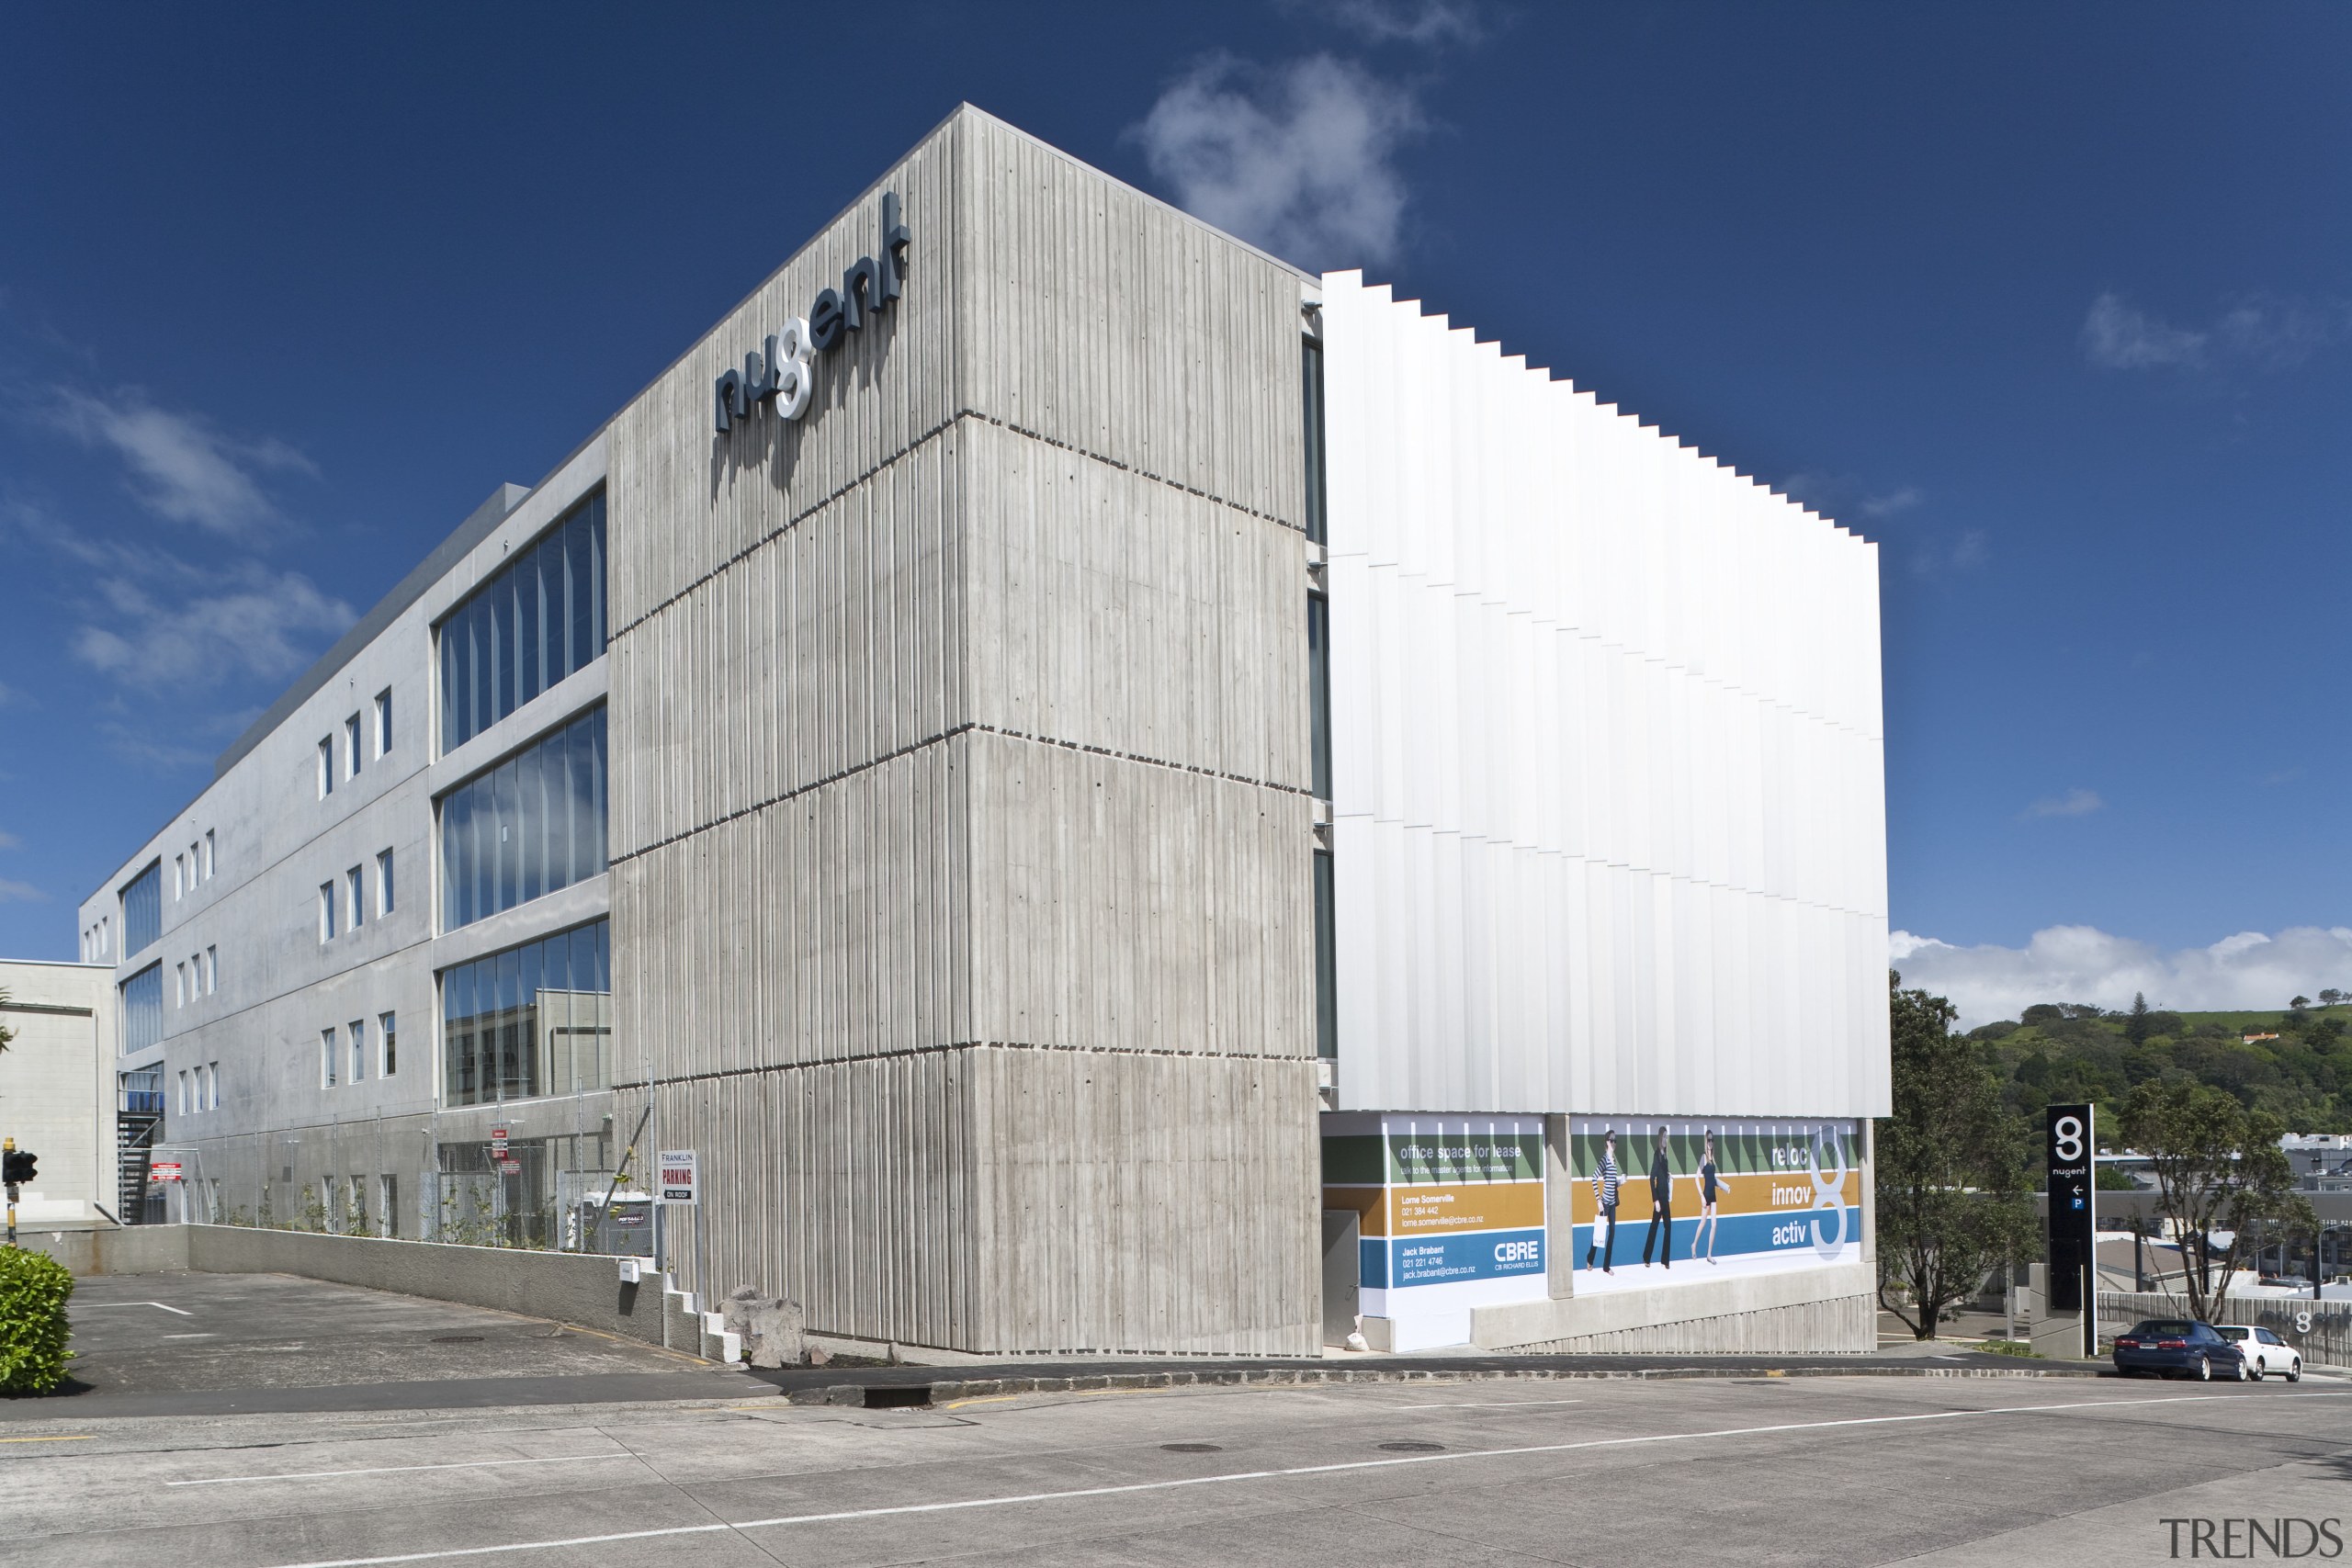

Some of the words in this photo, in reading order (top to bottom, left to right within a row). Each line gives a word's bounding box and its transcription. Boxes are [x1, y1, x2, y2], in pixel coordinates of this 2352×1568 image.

[2054, 1115, 2083, 1161] 8
[662, 1154, 693, 1162] FRANKLIN
[1400, 1145, 1433, 1159] office
[1437, 1146, 1470, 1162] space
[1475, 1145, 1489, 1157] for
[1493, 1144, 1521, 1157] lease
[1772, 1142, 1807, 1166] reloc
[1400, 1166, 1411, 1175] talk
[1412, 1166, 1419, 1174] to
[1419, 1165, 1430, 1174] the
[1431, 1166, 1451, 1174] master
[1453, 1166, 1472, 1175] agents
[1473, 1165, 1481, 1173] for
[1482, 1164, 1512, 1173] information
[2052, 1166, 2086, 1179] nugent
[662, 1168, 692, 1185] PARKING
[1401, 1195, 1419, 1204] Lorne
[1421, 1194, 1454, 1203] Somerville
[1771, 1182, 1811, 1206] innov
[2075, 1199, 2082, 1208] P
[1401, 1207, 1412, 1216] 021
[1414, 1207, 1425, 1215] 384
[1427, 1206, 1439, 1214] 442
[1772, 1220, 1806, 1246] activ
[1402, 1247, 1418, 1257] Jack
[1419, 1246, 1444, 1255] Brabant
[1494, 1240, 1539, 1261] CBRE
[1402, 1259, 1413, 1269] 021
[1416, 1258, 1426, 1268] 221
[1428, 1257, 1443, 1266] 4746
[1503, 1262, 1525, 1270] RICHARD
[1402, 1266, 1476, 1281] jack.brabant@cbre.co.nz
